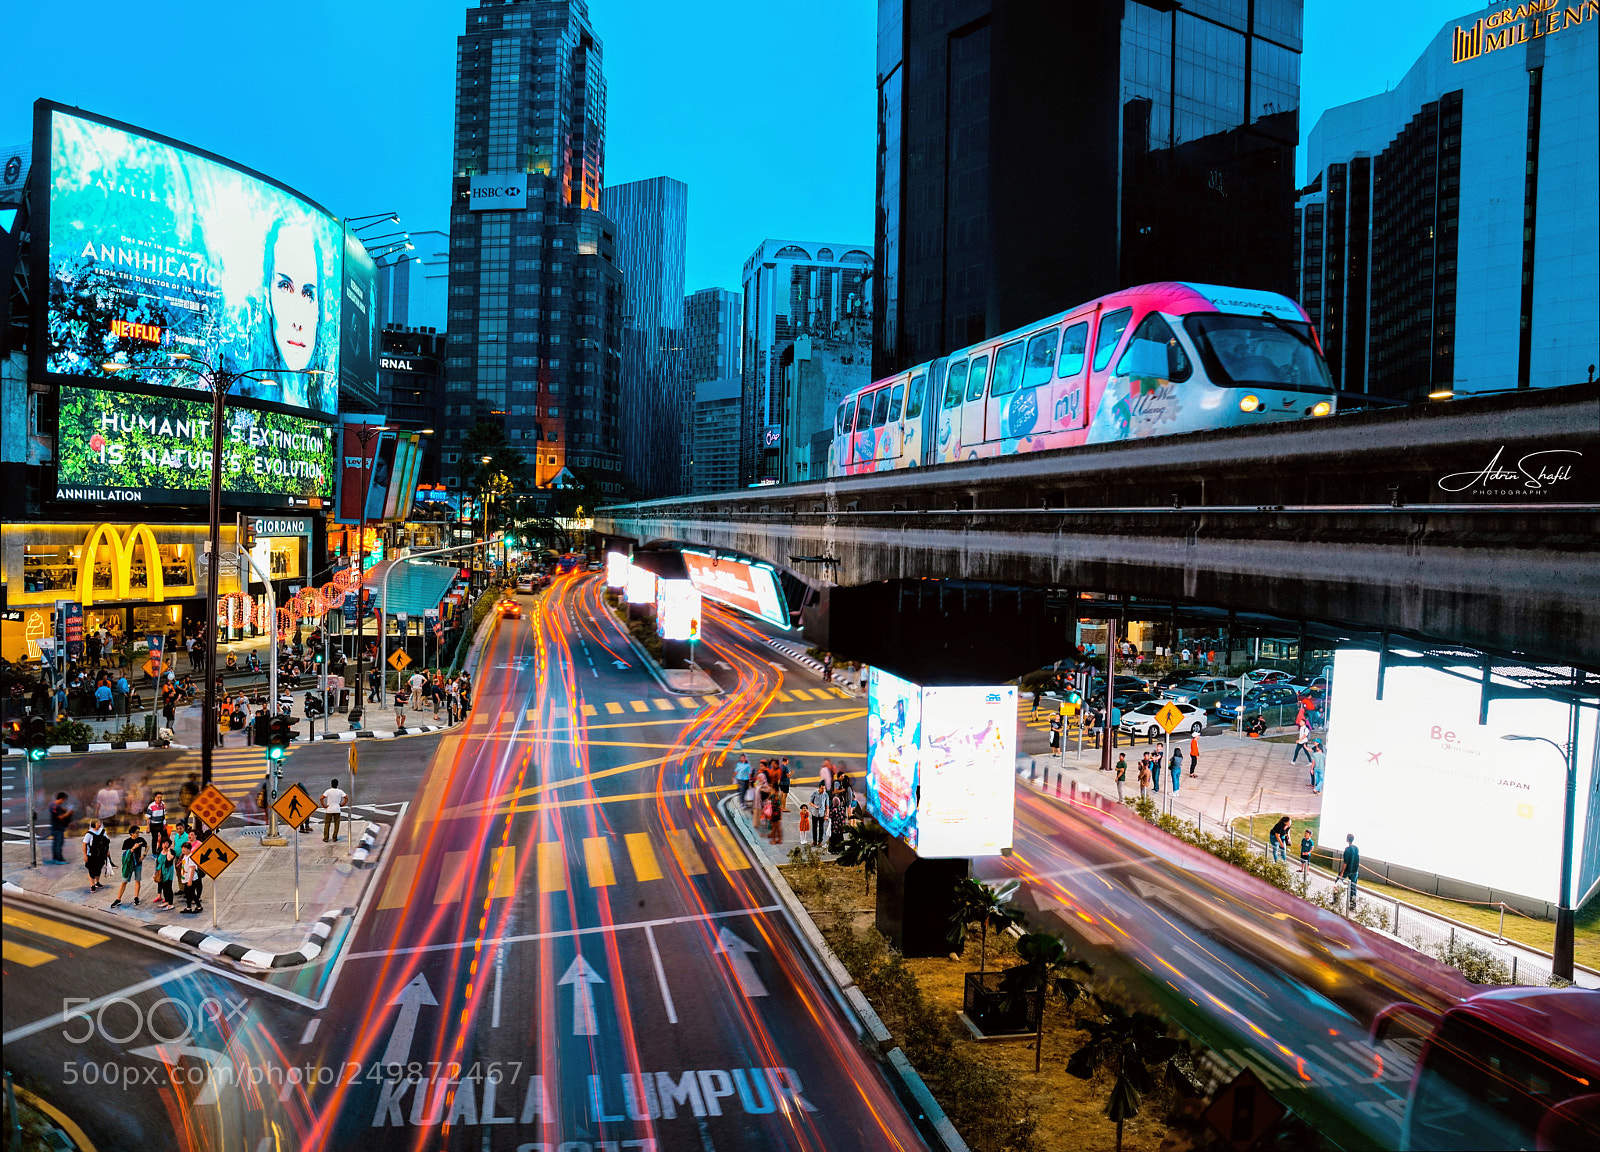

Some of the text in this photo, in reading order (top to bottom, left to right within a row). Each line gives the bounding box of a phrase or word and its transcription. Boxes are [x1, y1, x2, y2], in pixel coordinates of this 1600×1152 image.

[1486, 0, 1559, 29] GRAND
[473, 186, 503, 198] HSBC
[81, 240, 222, 287] ANNIHILATIO
[95, 267, 116, 278] FROM
[118, 271, 133, 281] THE
[135, 275, 170, 288] DIRECTOR
[111, 319, 161, 344] NETFLIX
[249, 426, 323, 453] EXTINCTION
[100, 443, 124, 464] IS
[254, 456, 323, 479] EVOLUTION
[56, 488, 142, 501] ANNIHILATION
[255, 519, 304, 534] GIORDANO
[1497, 779, 1531, 791] JAPAN
[372, 1067, 819, 1128] KUALA LUMPUR
